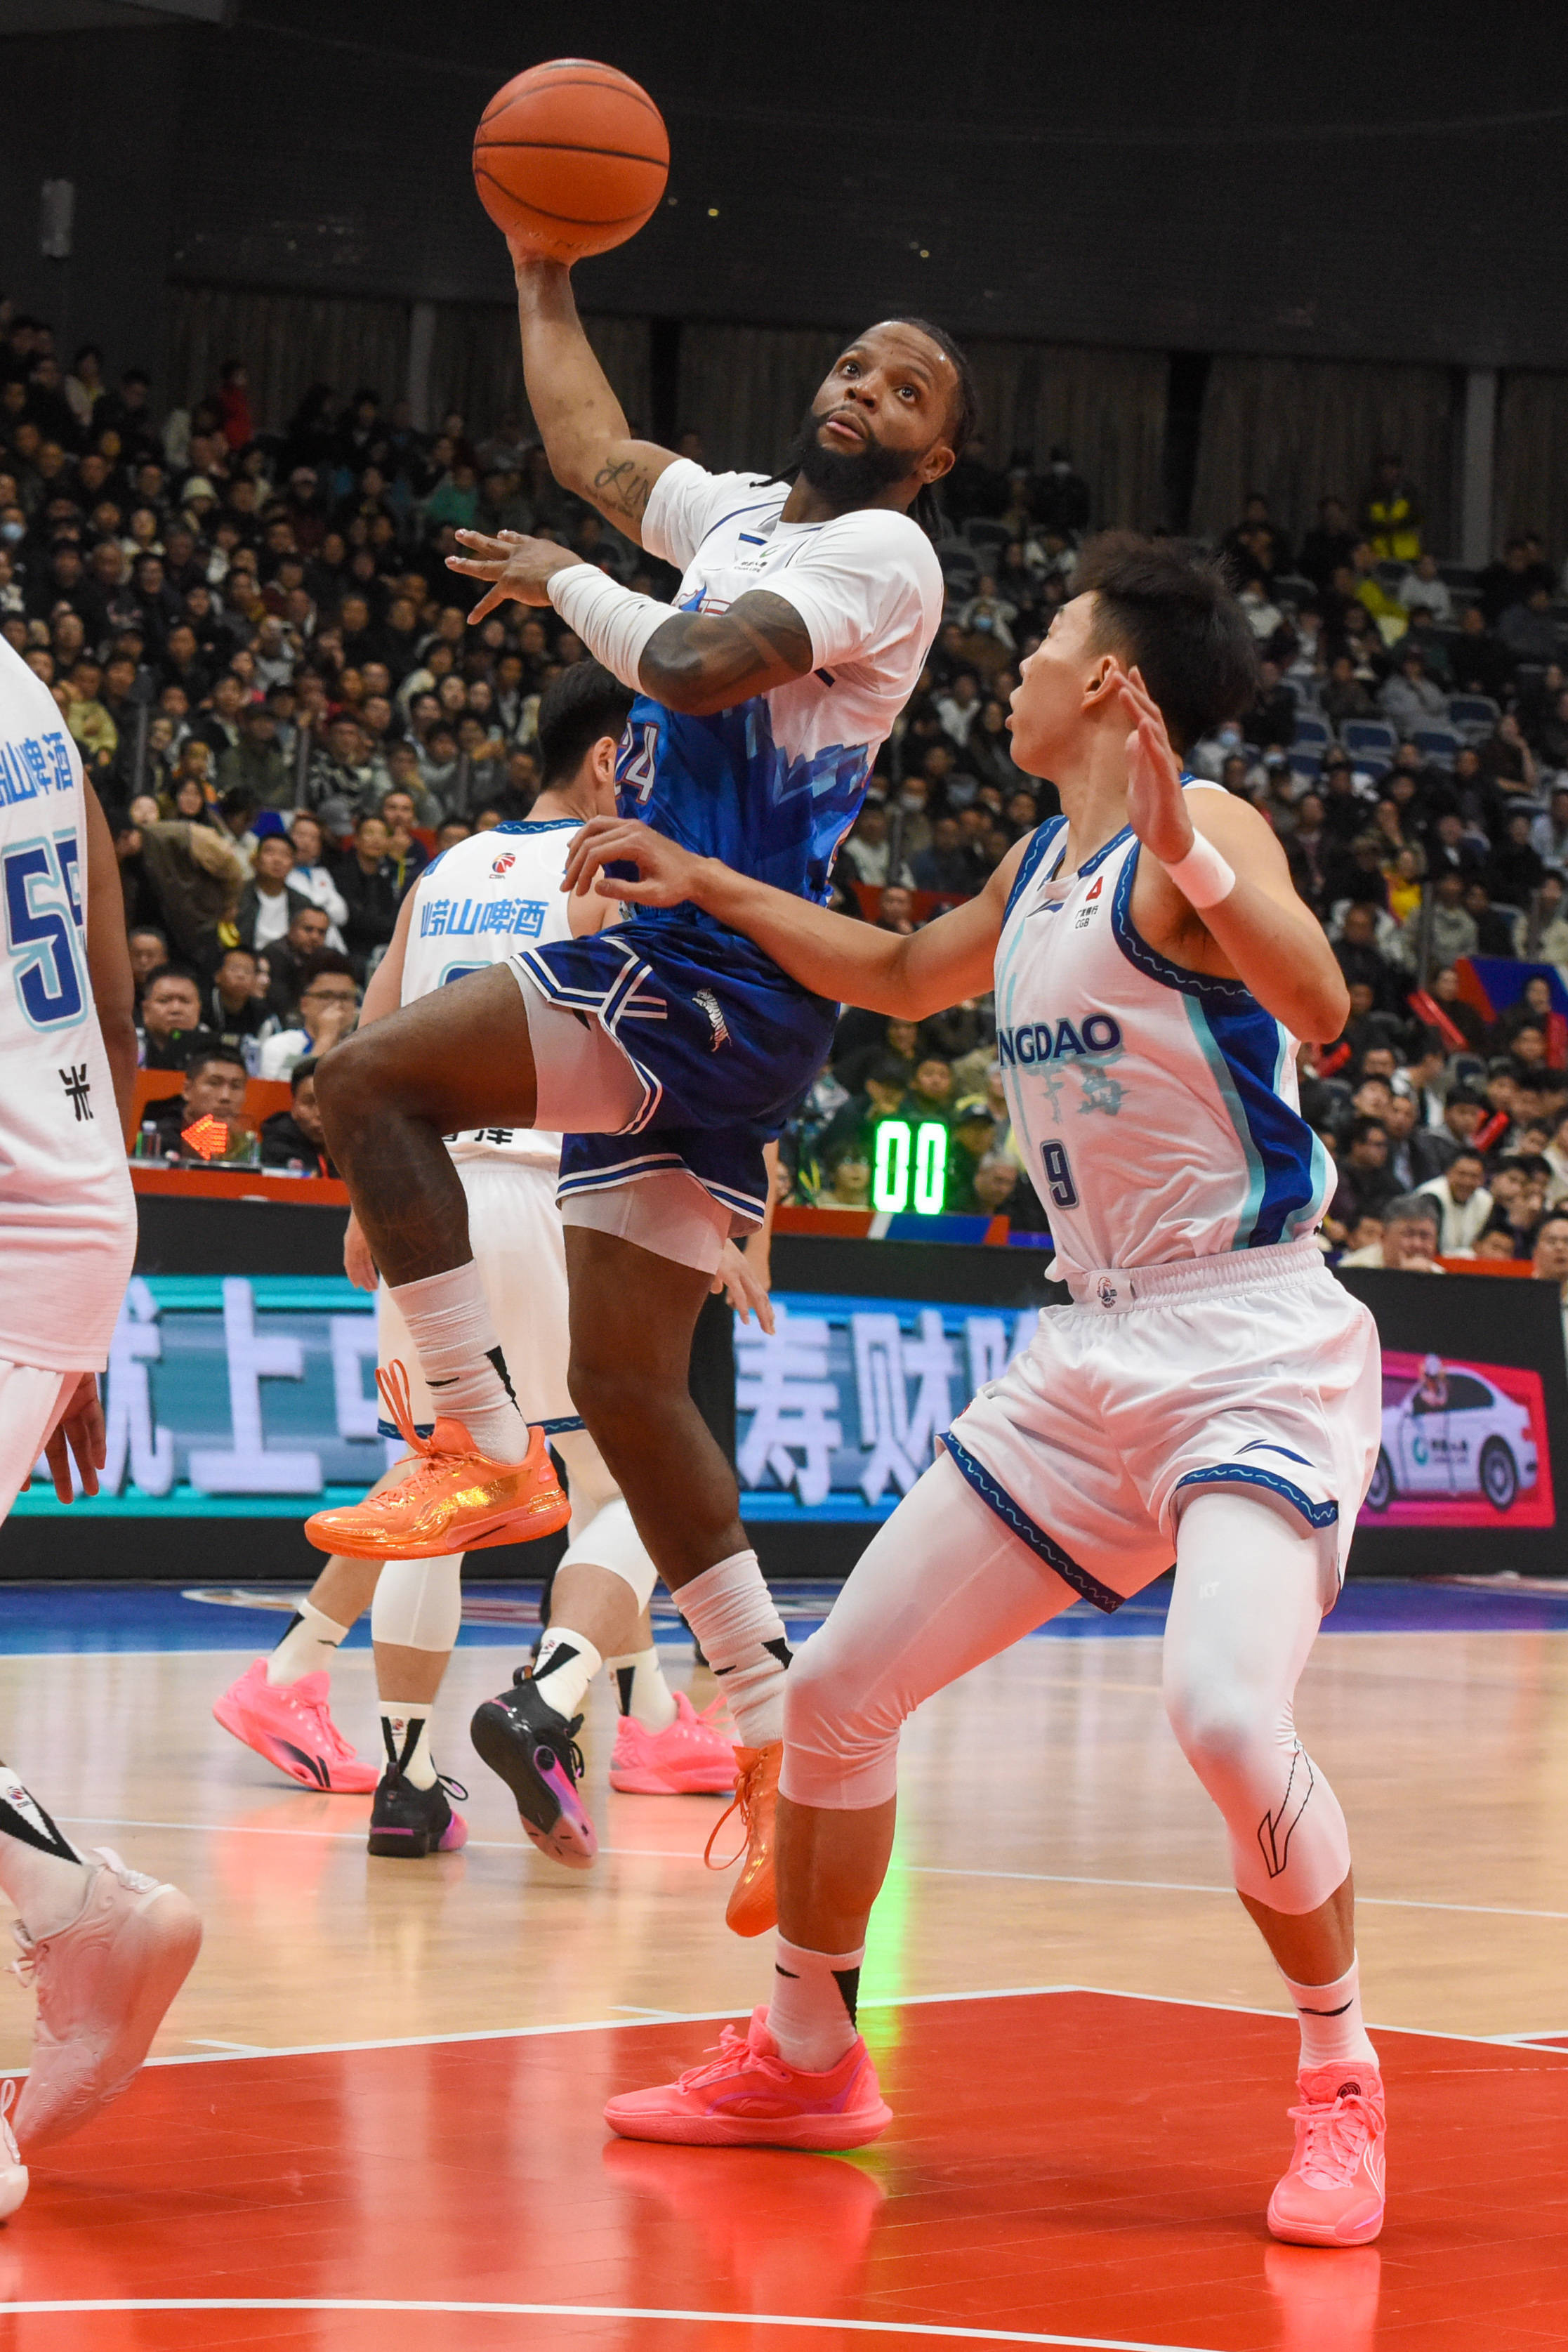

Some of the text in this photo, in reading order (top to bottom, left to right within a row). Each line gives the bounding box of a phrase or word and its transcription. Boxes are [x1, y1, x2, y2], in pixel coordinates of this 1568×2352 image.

[0, 731, 74, 809] 山啤酒
[1075, 917, 1090, 929] CGB
[873, 1119, 947, 1214] 00
[1040, 1139, 1079, 1210] 9
